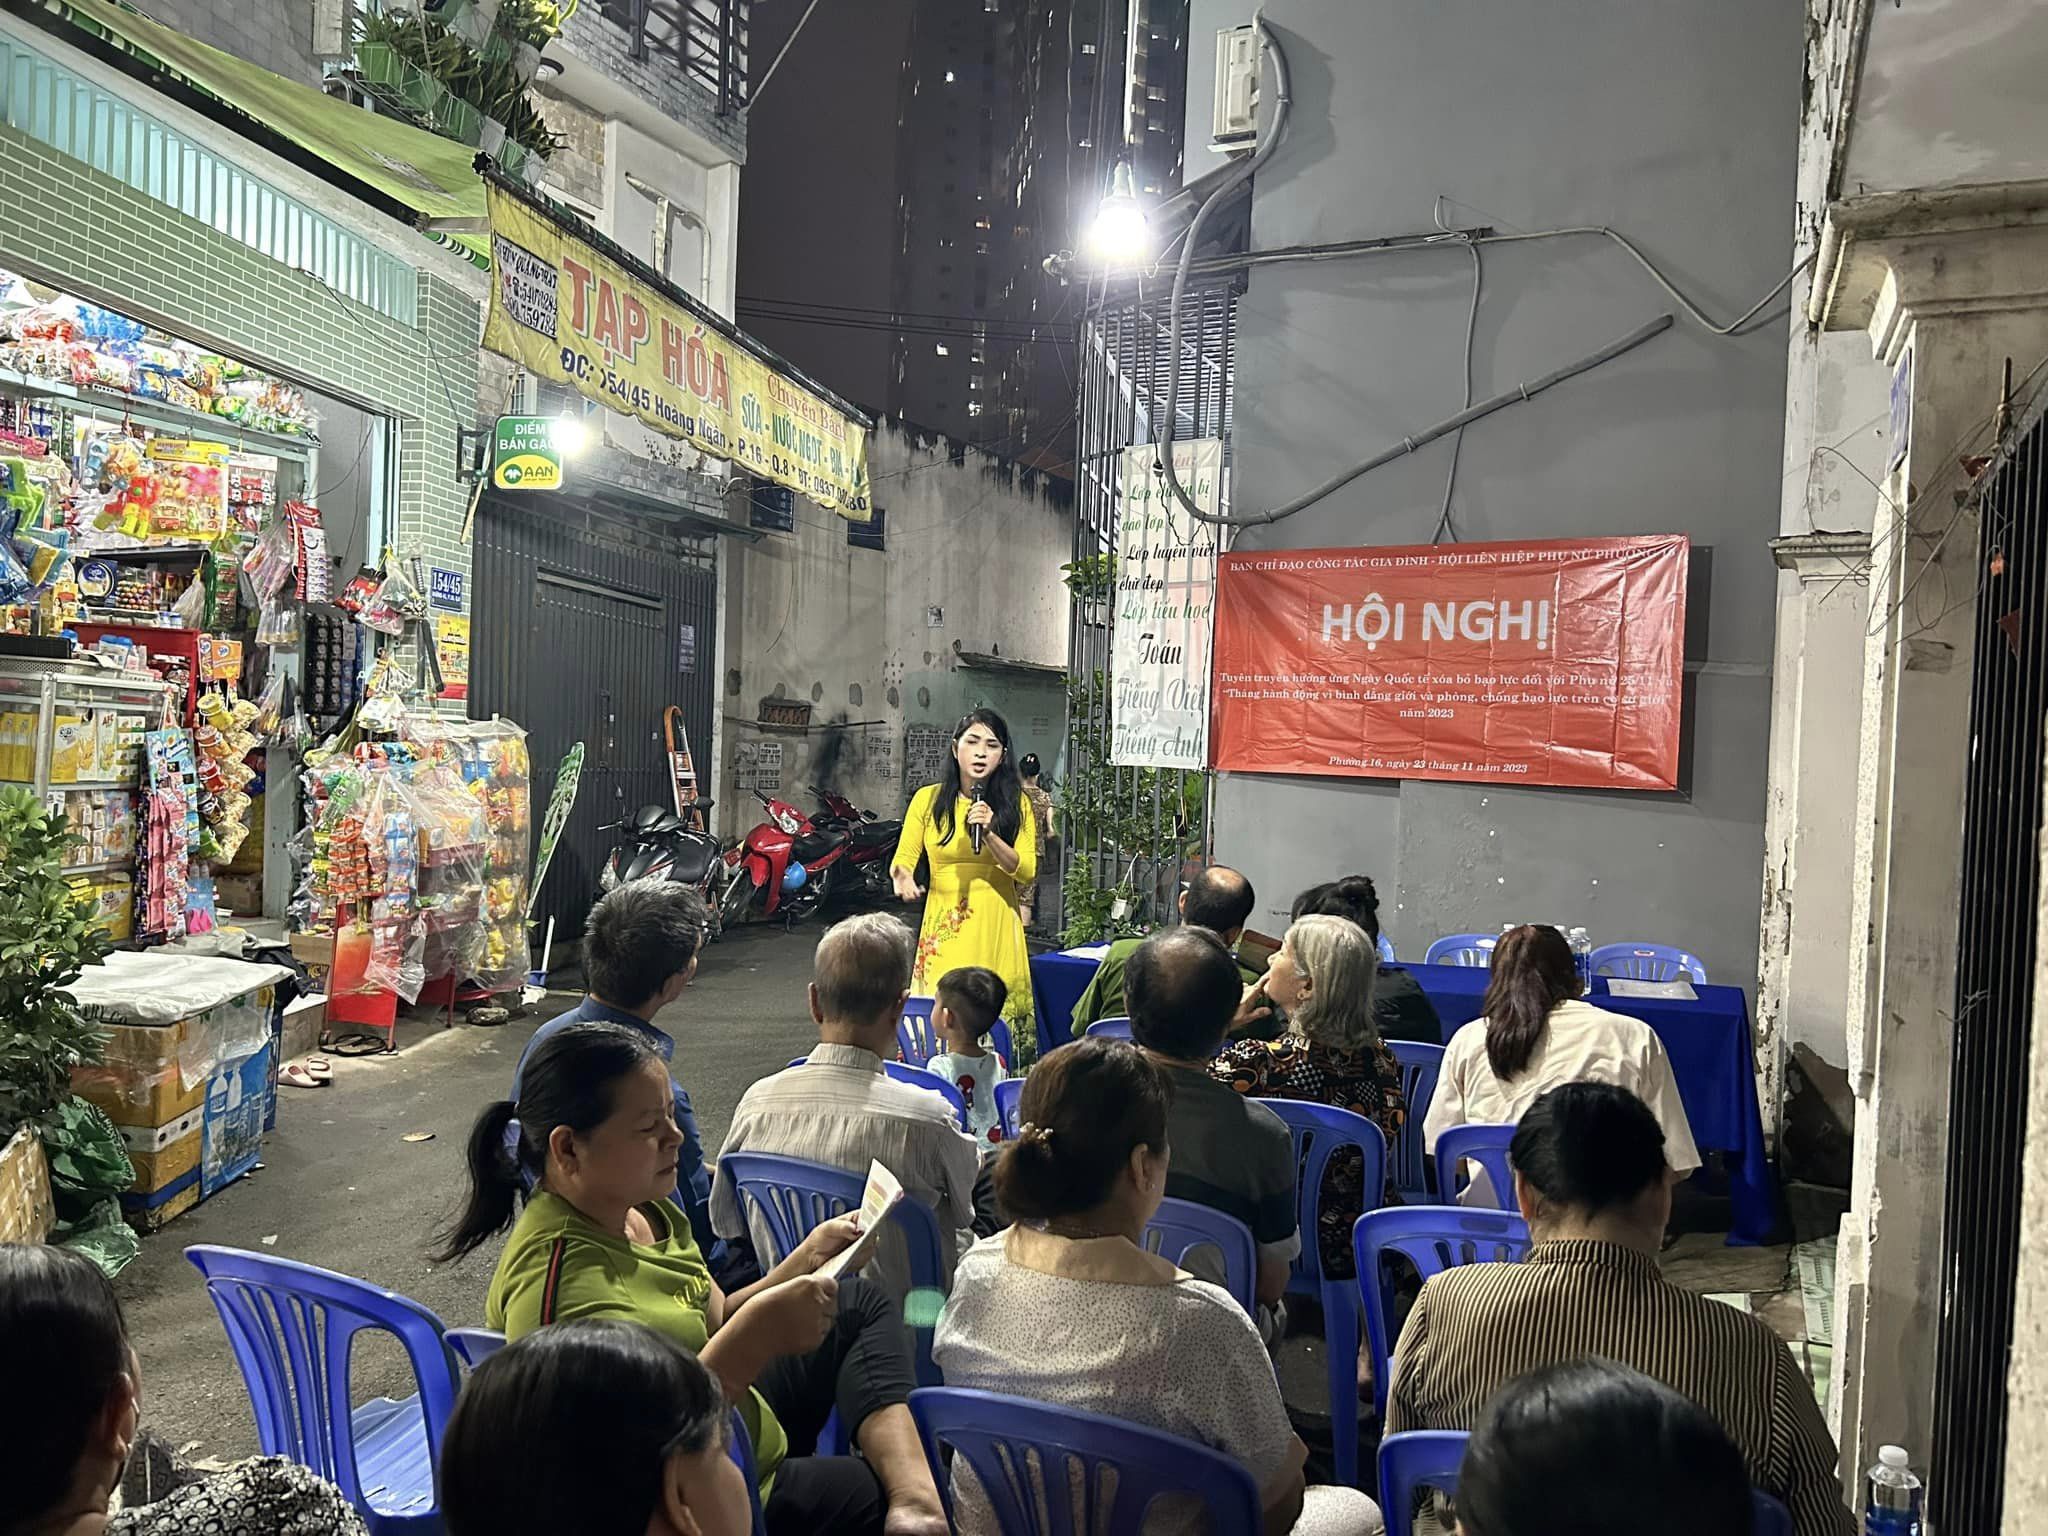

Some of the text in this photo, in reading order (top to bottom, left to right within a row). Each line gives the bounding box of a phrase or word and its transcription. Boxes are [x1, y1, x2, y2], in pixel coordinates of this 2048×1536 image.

[563, 256, 732, 417] TẠP HÓA
[768, 374, 817, 424] Chuyên
[560, 347, 594, 381] ĐC:
[655, 395, 694, 437] Hoàng
[772, 454, 789, 476] Q.8
[515, 420, 546, 435] ĐIỂM
[741, 392, 762, 435] SỮA
[772, 412, 798, 454] NƯỚC
[799, 429, 822, 471] NGỌT
[830, 446, 844, 478] BIA
[500, 437, 526, 450] BÁN
[525, 466, 553, 477] AAN
[1129, 483, 1151, 503] Lớp
[1198, 478, 1210, 498] bị
[1145, 513, 1163, 532] lớp
[1126, 544, 1149, 564] Lớp
[1153, 543, 1186, 562] luyện
[1230, 562, 1253, 572] BAN
[1256, 558, 1277, 570] CHỈ
[1278, 560, 1304, 572] ĐẠO
[1307, 558, 1340, 569] CÔNG
[1345, 556, 1368, 568] TÁC
[1370, 558, 1393, 567] GIA
[1395, 555, 1428, 567] ĐÌNH
[1438, 552, 1463, 567] HỘI
[1466, 551, 1497, 564] LIÊN
[1501, 550, 1535, 565] HIỆP
[1538, 550, 1566, 562] PHỤ
[1571, 548, 1593, 560] NỮ
[433, 572, 461, 594] 154/45
[1142, 574, 1163, 593] đẹp
[1152, 597, 1177, 619] tiểu
[1183, 598, 1209, 623] học
[1321, 592, 1549, 650] HỘI NGHỊ
[1138, 633, 1182, 664] Toán
[1220, 672, 1251, 684] Tuyên
[1254, 672, 1290, 684] truyền
[1292, 672, 1326, 684] hưởng
[1329, 672, 1349, 684] ứng
[1352, 673, 1381, 685] Ngày
[1385, 672, 1415, 685] Quốc
[1418, 672, 1431, 684] tế
[1432, 674, 1453, 684] xóa
[1457, 673, 1471, 684] bỏ
[1475, 674, 1497, 687] bạo
[1500, 674, 1519, 687] lực
[1522, 673, 1542, 685] đối
[1546, 674, 1565, 685] với
[1569, 674, 1596, 687] Phụ
[1117, 678, 1160, 716] Tiếng
[1263, 689, 1289, 699] hành
[1292, 689, 1319, 701] động
[1322, 689, 1332, 699] vì
[1336, 689, 1360, 700] bình
[1363, 688, 1391, 701] đẳng
[1394, 691, 1417, 702] giới
[1420, 691, 1434, 701] và
[1437, 691, 1478, 703] phòng,
[1481, 690, 1519, 704] chống
[1522, 692, 1545, 705] bạo
[1549, 692, 1568, 705] lực
[1571, 693, 1599, 704] trên
[1400, 708, 1454, 719] năm 2023
[1163, 726, 1202, 759] Anh
[1328, 756, 1528, 774] Phường 16, ngày 23 tháng 11 năm 2023
